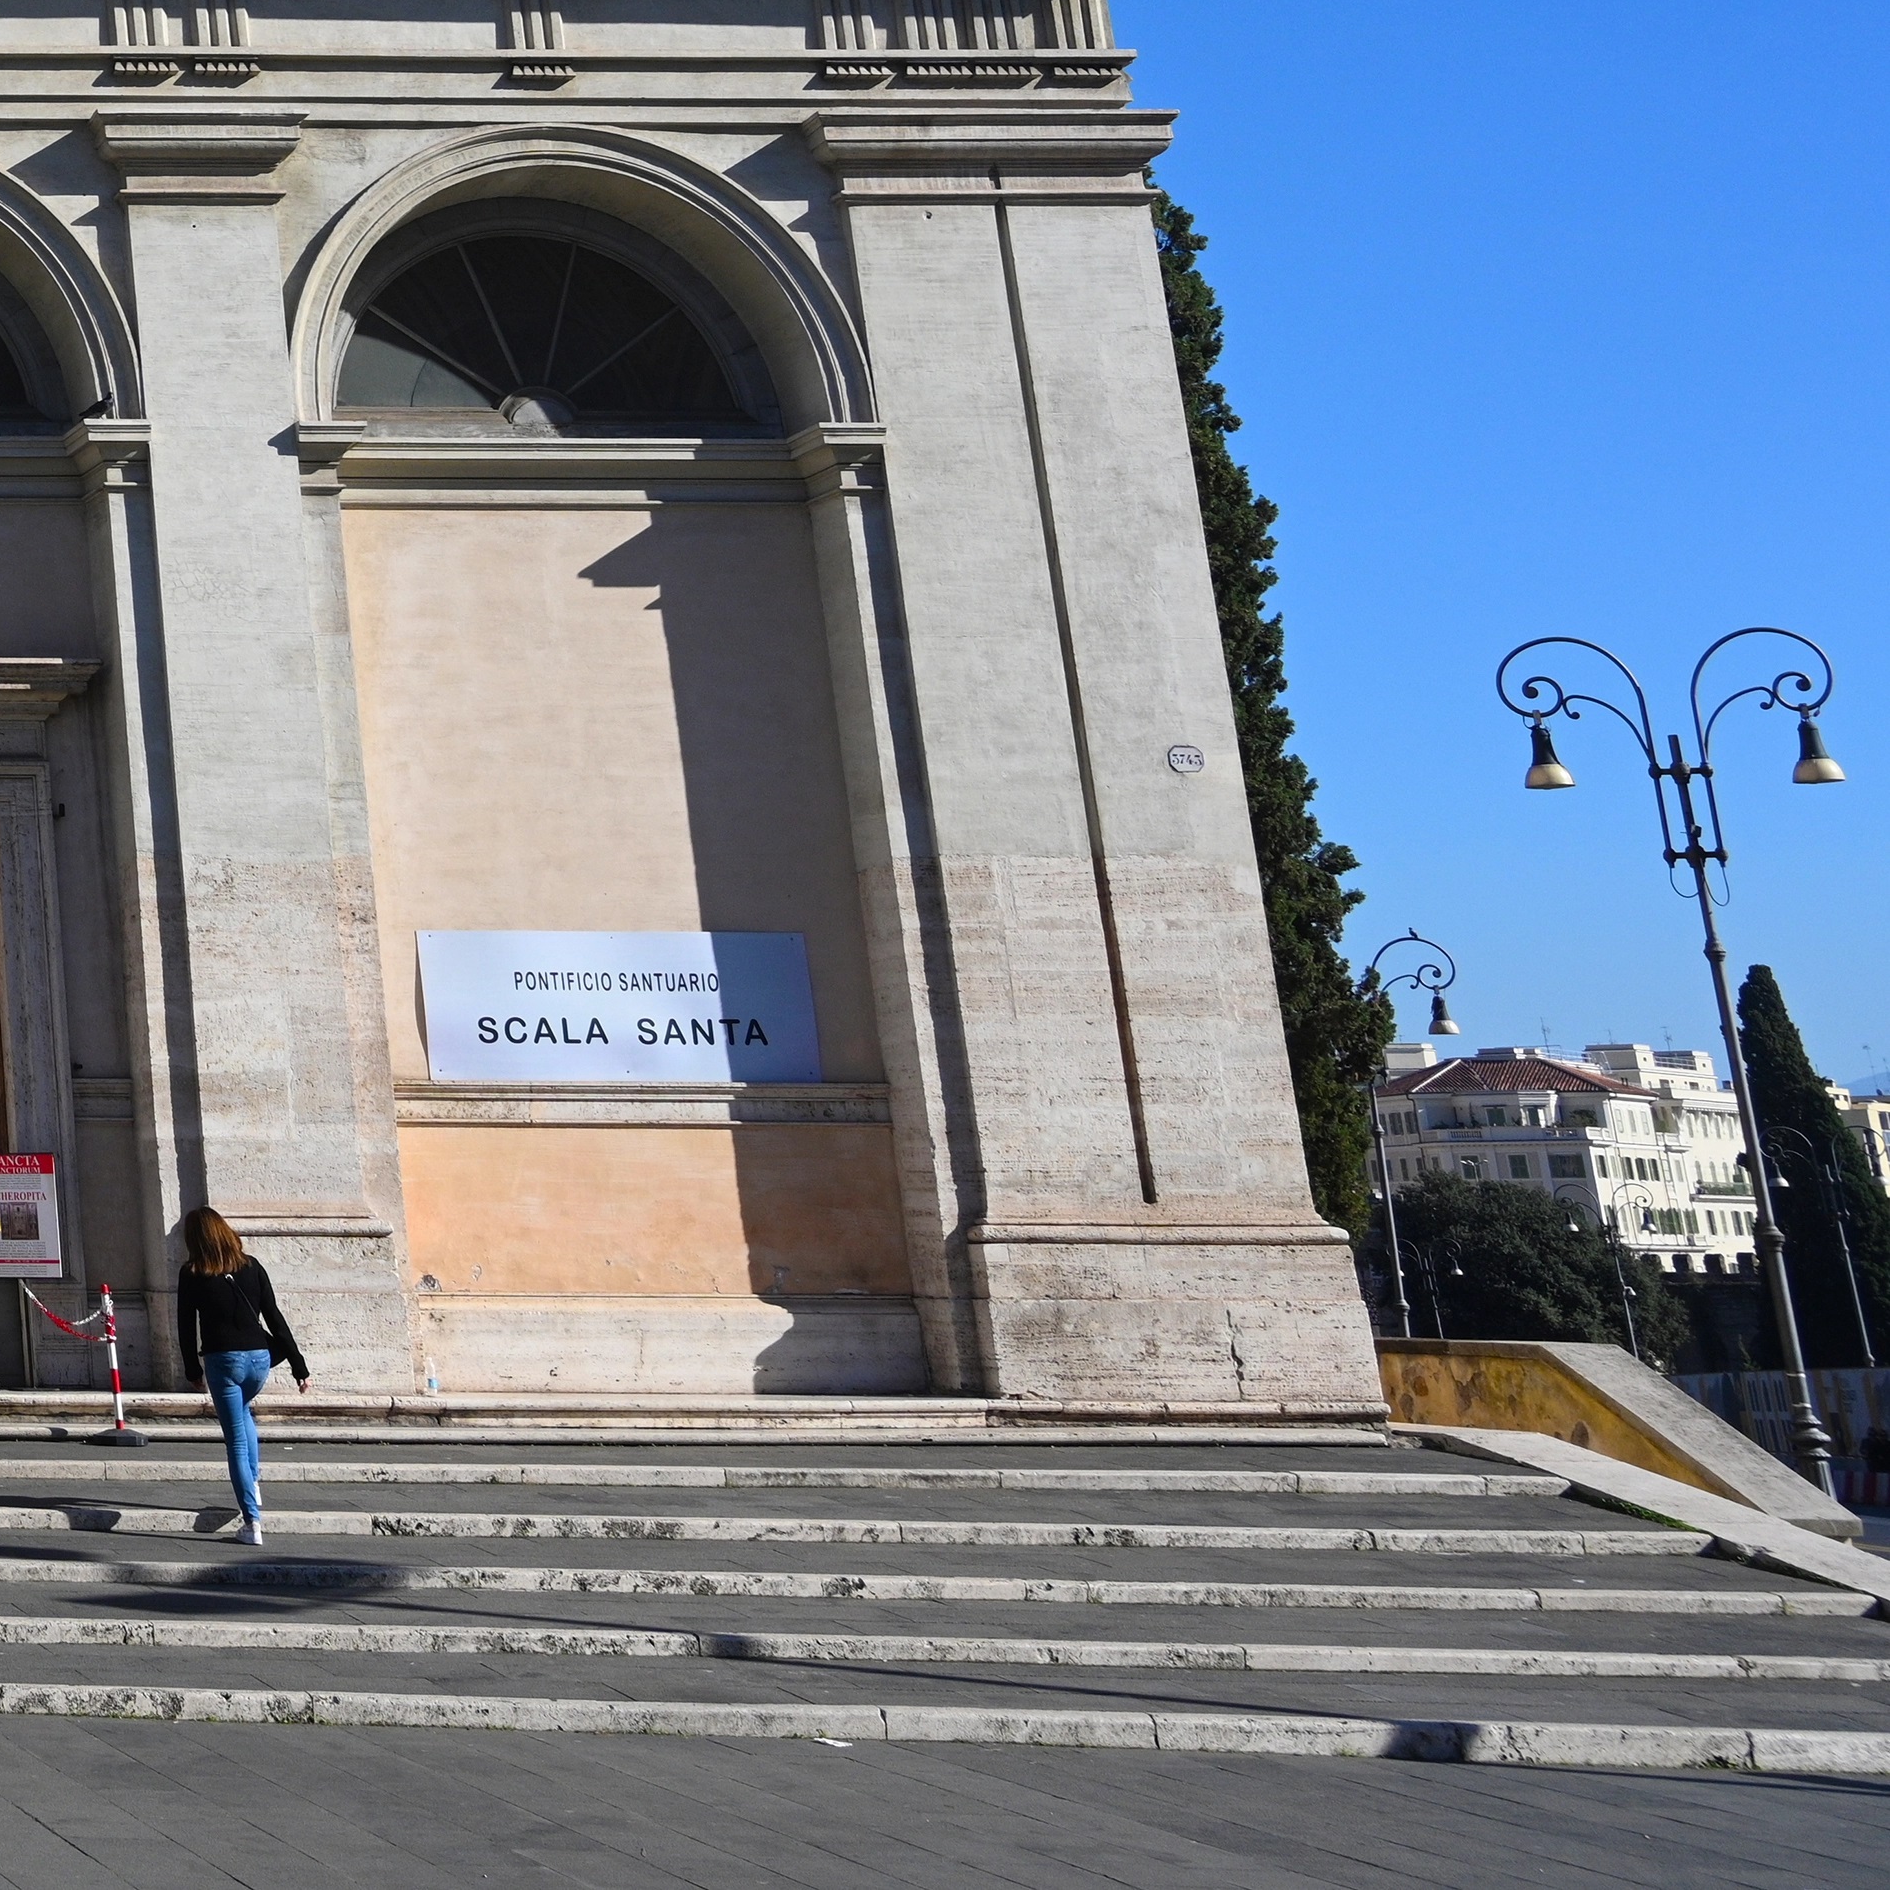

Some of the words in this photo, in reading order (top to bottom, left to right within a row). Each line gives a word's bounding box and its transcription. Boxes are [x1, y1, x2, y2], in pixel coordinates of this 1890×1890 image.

[513, 971, 612, 992] PONTIFICIO
[618, 972, 720, 992] SANTUARIO
[477, 1016, 609, 1045] SCALA
[637, 1017, 769, 1046] SANTA
